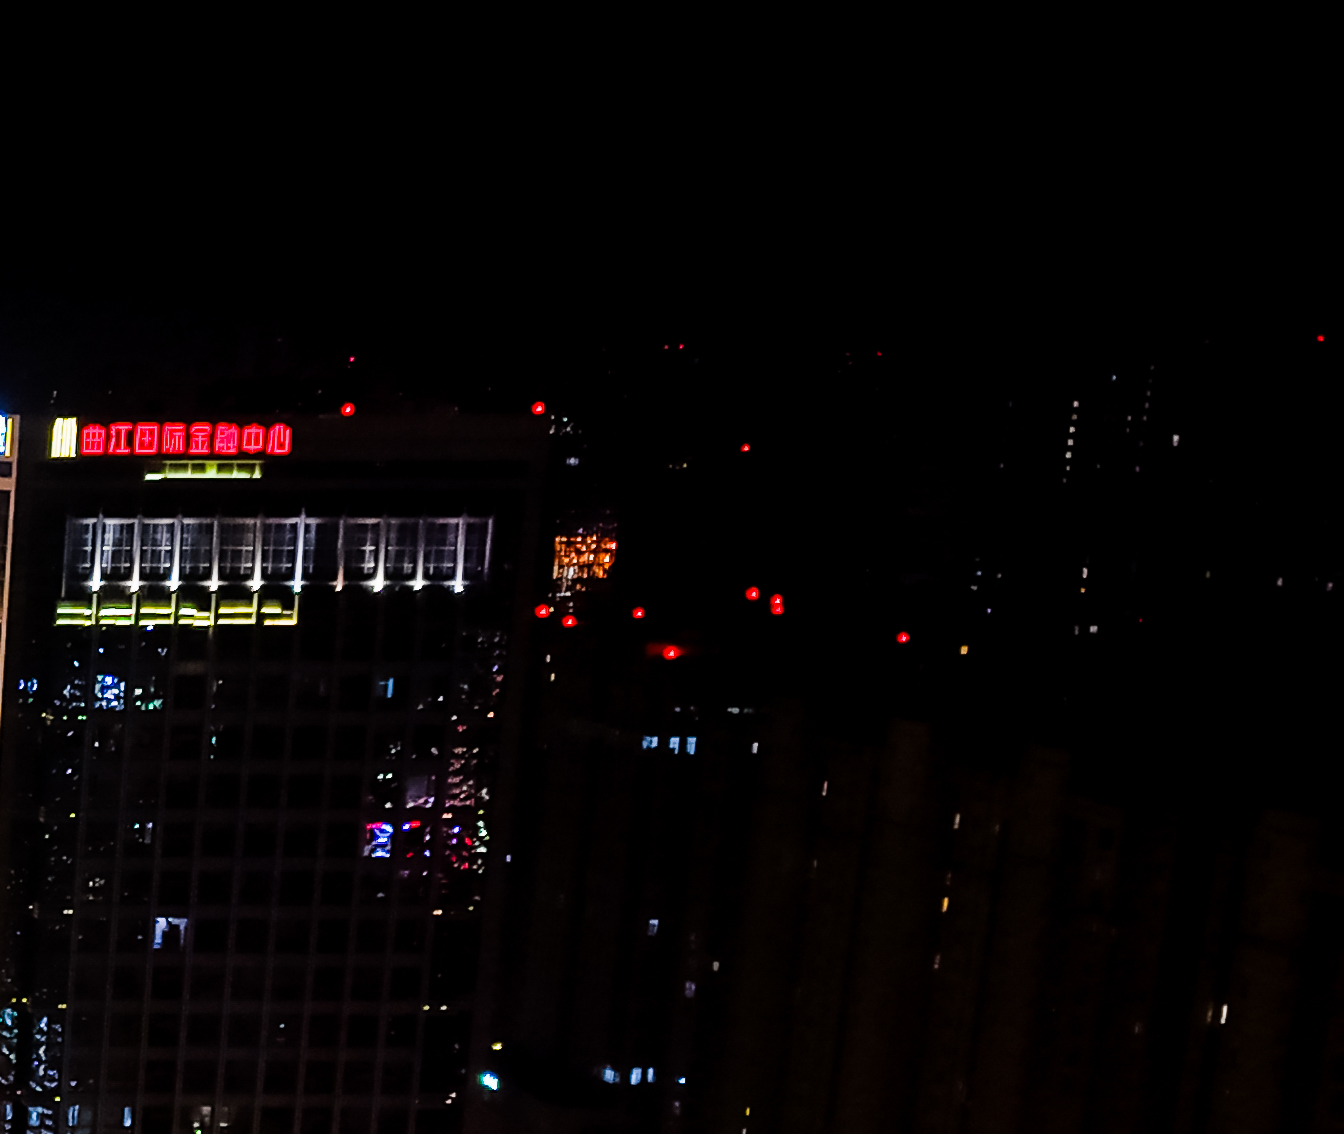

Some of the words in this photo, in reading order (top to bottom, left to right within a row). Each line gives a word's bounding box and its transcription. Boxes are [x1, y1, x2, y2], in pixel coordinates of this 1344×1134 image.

[80, 422, 293, 456] 曲江国际金融中心
